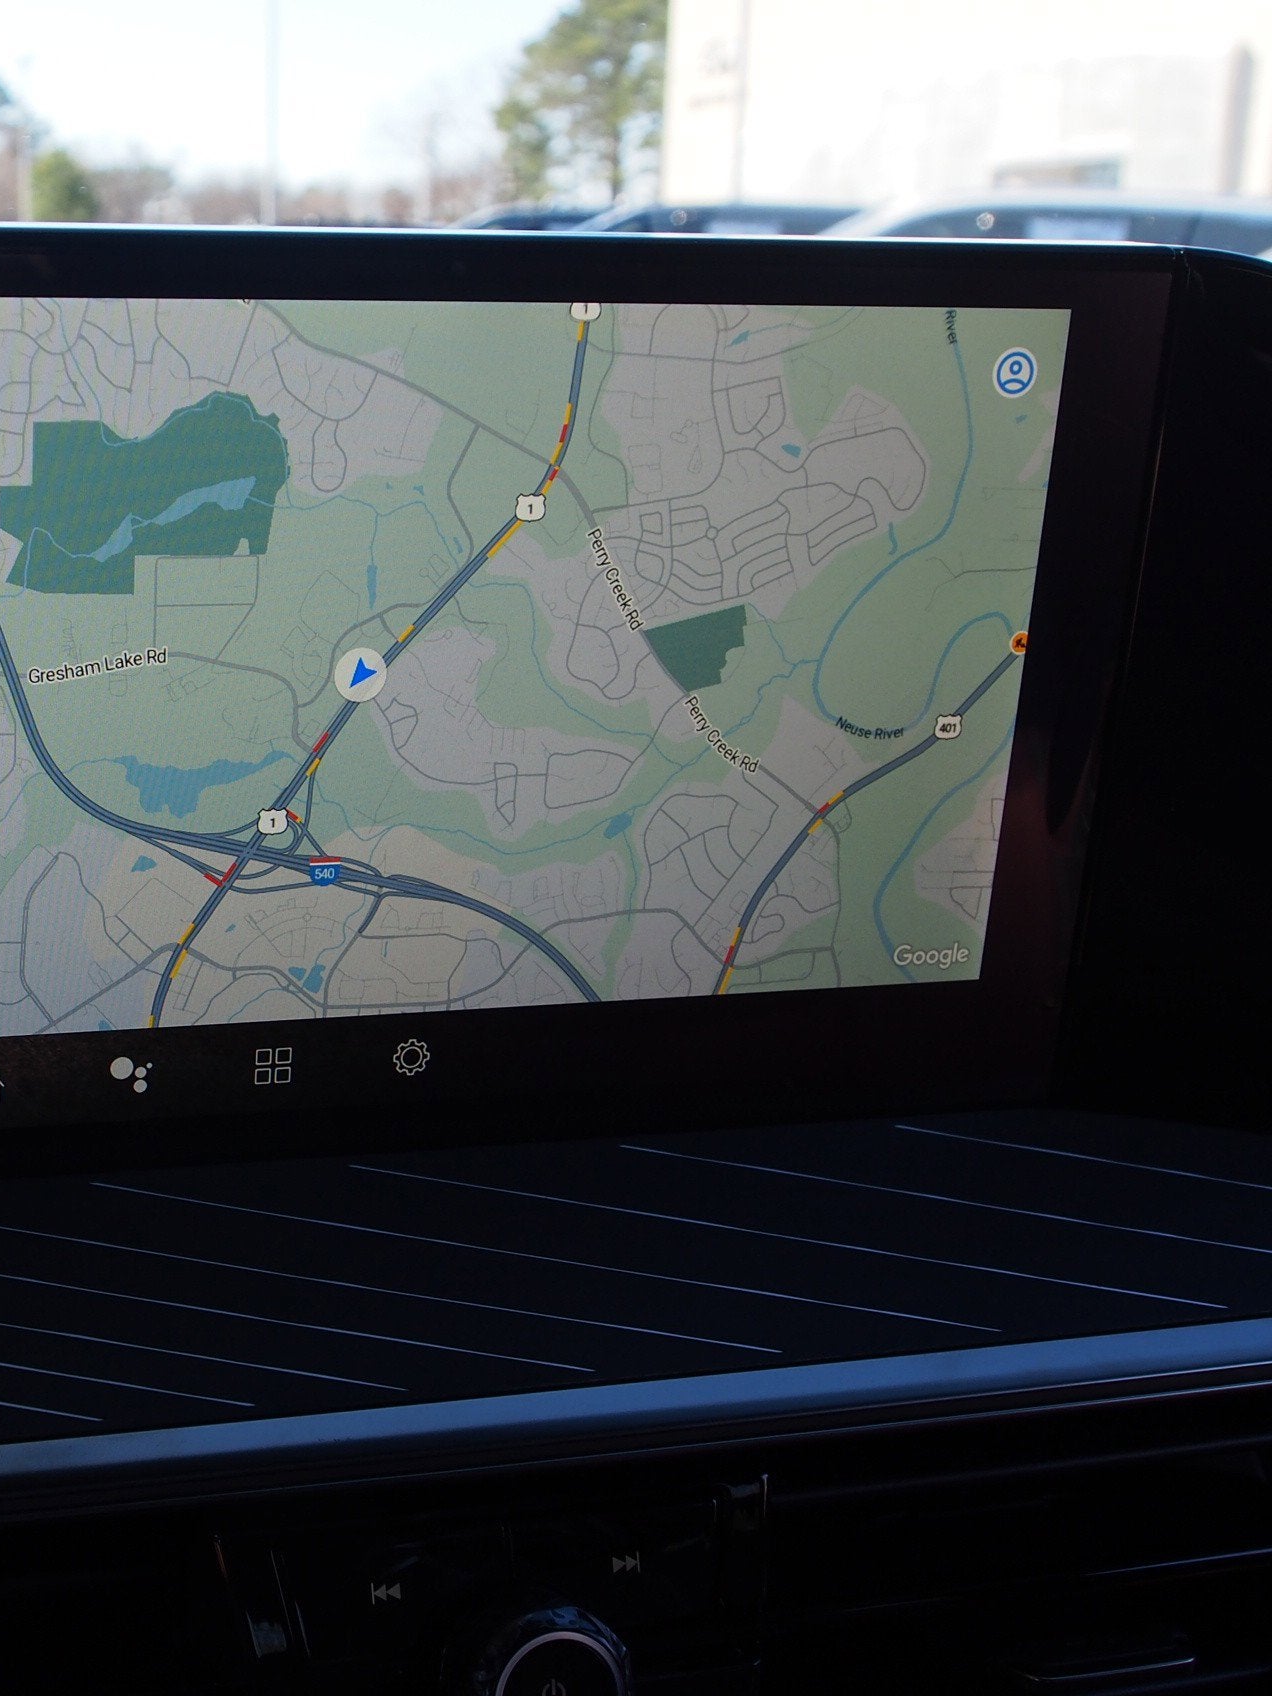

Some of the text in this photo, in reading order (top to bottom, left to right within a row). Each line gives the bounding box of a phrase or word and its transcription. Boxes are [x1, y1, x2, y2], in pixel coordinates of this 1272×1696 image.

[944, 309, 958, 345] River
[587, 528, 645, 631] Perry Creek Rd
[28, 648, 167, 684] Gresham Lake Rd
[684, 695, 760, 773] Perry Creek Rd
[835, 716, 904, 740] Neuse River
[939, 723, 957, 733] 401
[314, 868, 335, 880] 540
[893, 942, 970, 970] Google
